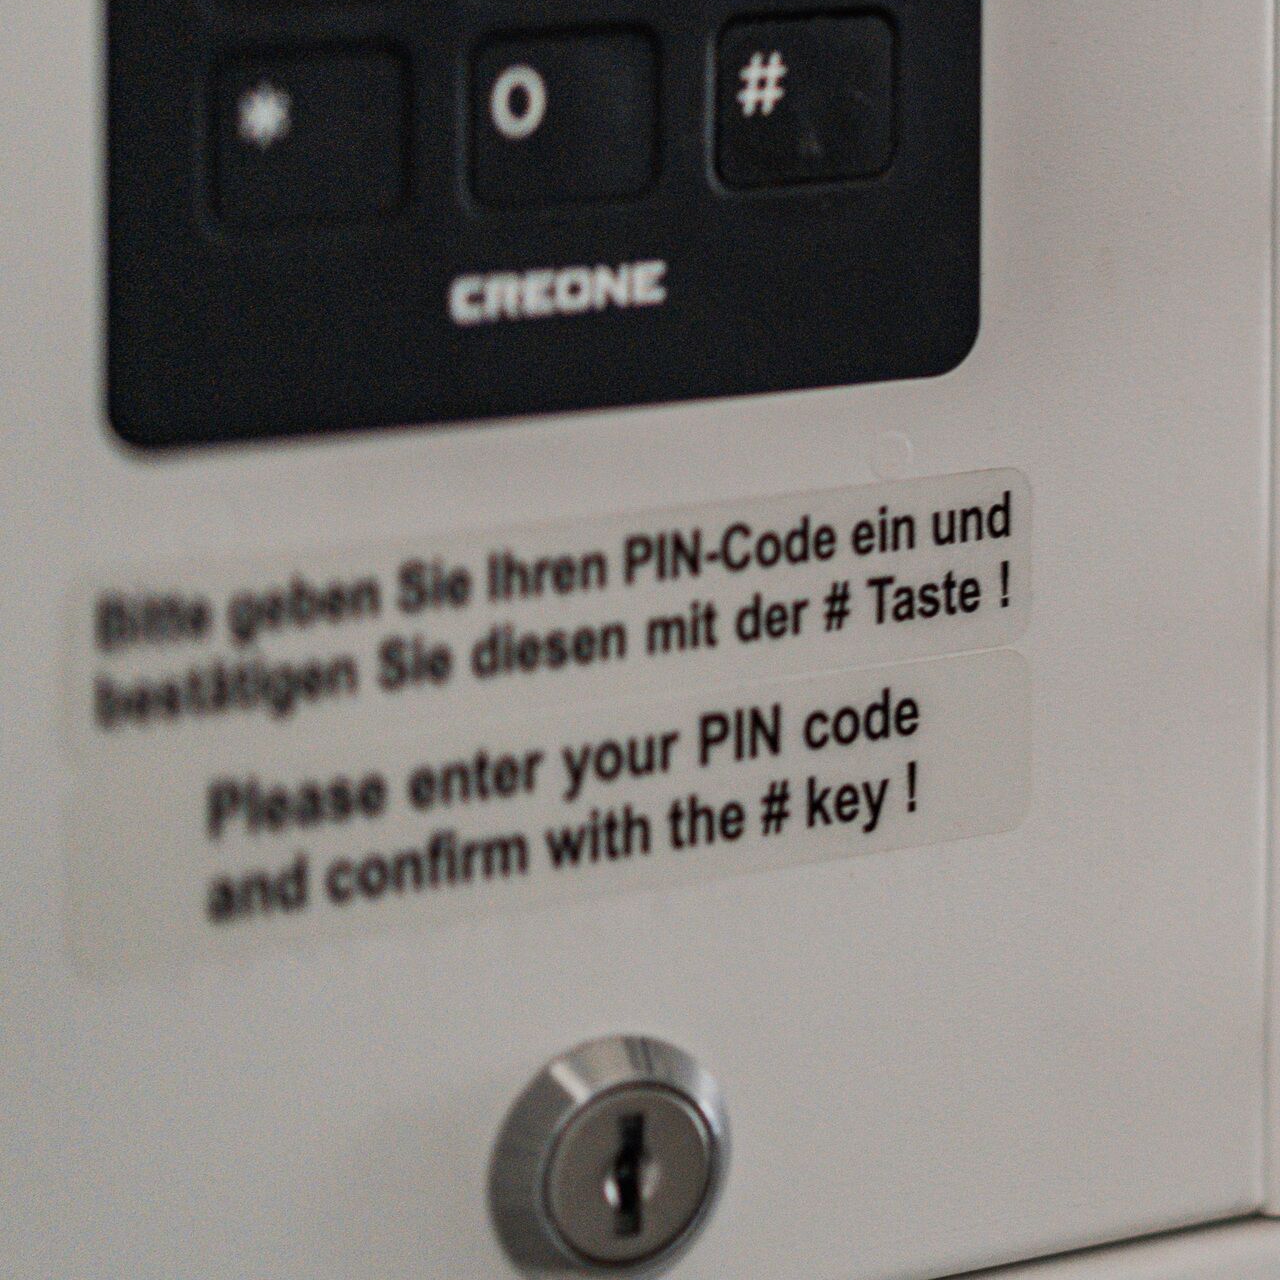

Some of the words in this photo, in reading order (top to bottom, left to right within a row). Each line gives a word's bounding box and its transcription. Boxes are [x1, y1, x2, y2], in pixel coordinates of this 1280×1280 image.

[489, 64, 548, 139] 0
[92, 593, 215, 656] Bitte
[225, 577, 382, 655] geben
[396, 558, 474, 617] Sie
[485, 550, 606, 603] Ihren
[621, 513, 840, 587] PIN-Code
[848, 504, 919, 556] ein
[929, 489, 1014, 547] und
[376, 635, 455, 694] Sie
[469, 621, 629, 681] diesen
[644, 600, 720, 656] mit
[732, 591, 811, 646] der
[864, 570, 984, 626] Taste
[204, 772, 390, 840] Please
[405, 749, 545, 813] enter
[560, 729, 682, 804] your
[696, 702, 784, 768] PIN
[800, 685, 922, 753] code
[205, 853, 311, 926] and
[322, 828, 532, 908] confirm
[543, 804, 653, 870] with
[665, 793, 748, 852] the
[804, 775, 891, 836] key
